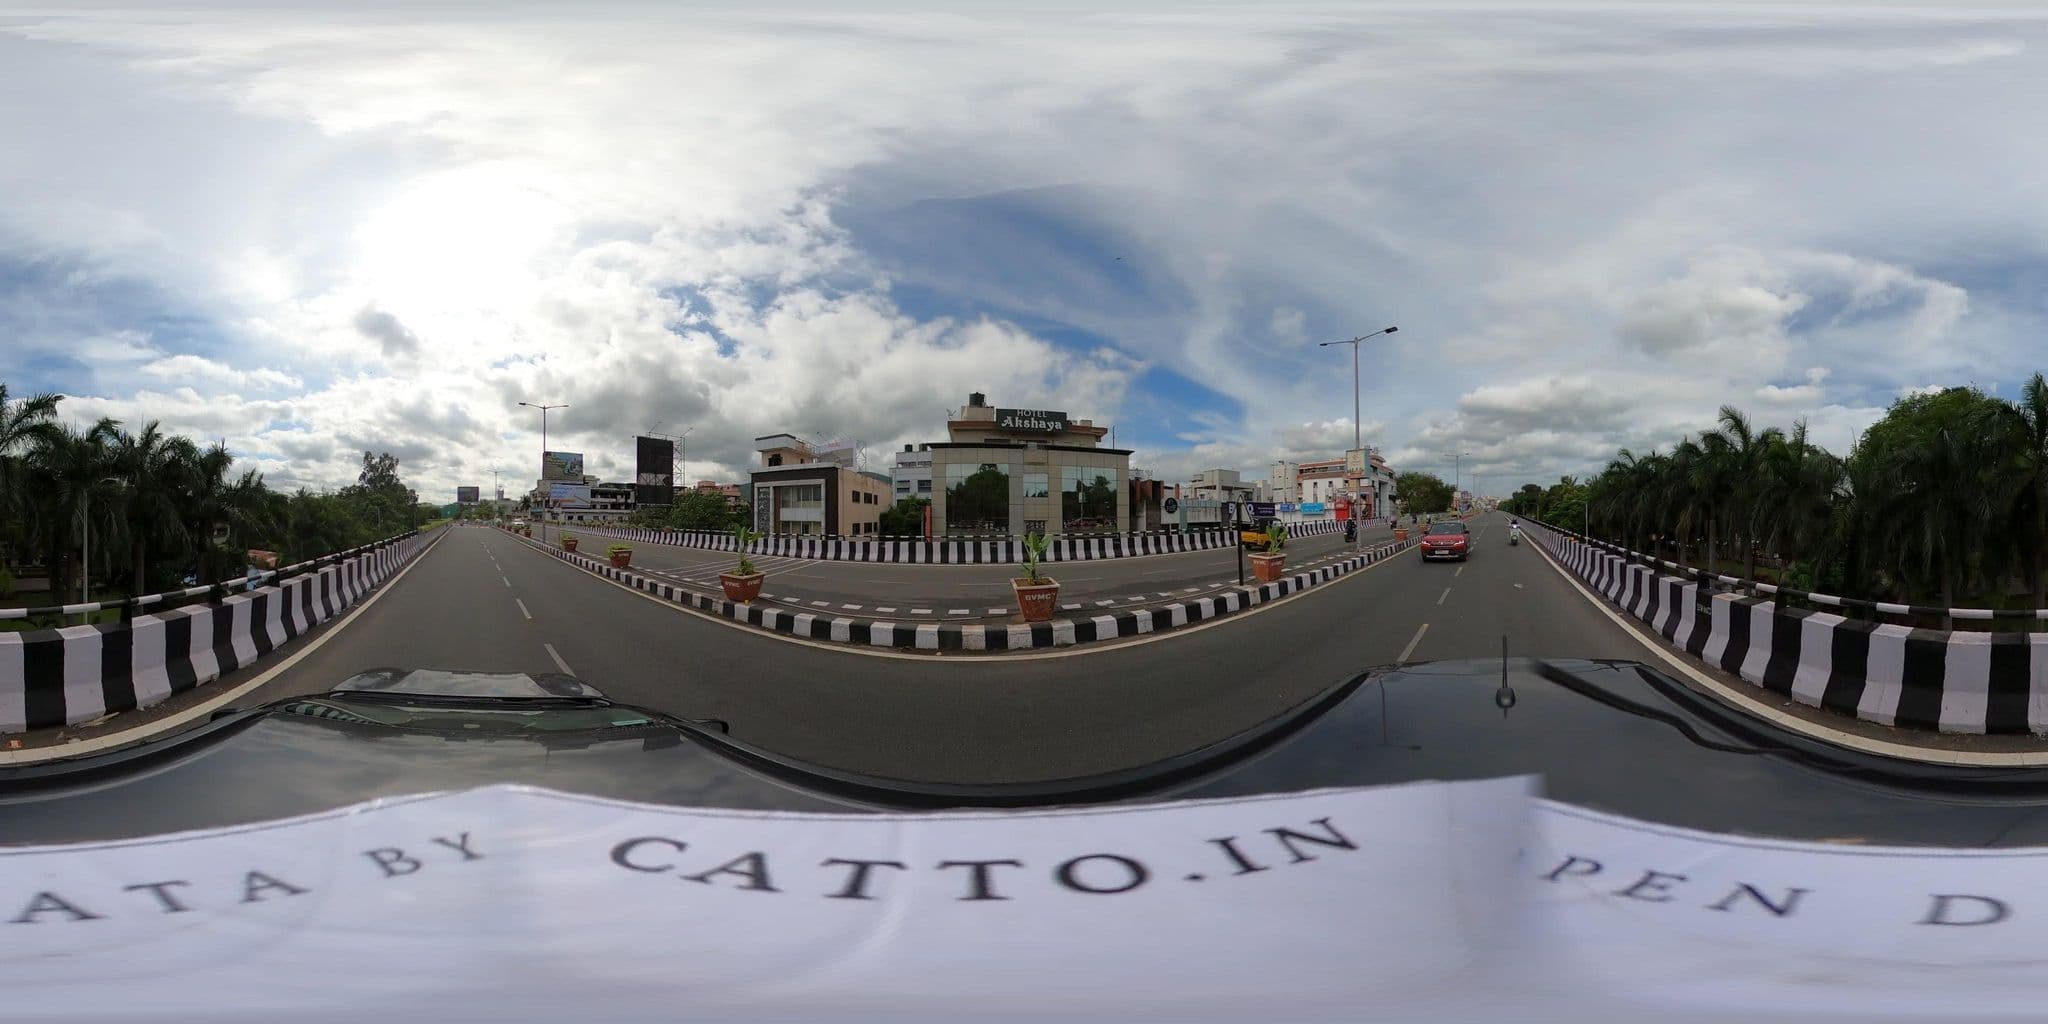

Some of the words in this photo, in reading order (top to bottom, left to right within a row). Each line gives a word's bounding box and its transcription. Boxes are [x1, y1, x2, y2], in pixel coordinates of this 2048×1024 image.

[1016, 409, 1048, 418] HOTEL
[1001, 415, 1063, 432] Akshaya
[362, 831, 486, 879] BY
[609, 816, 1361, 902] CATTO.IN
